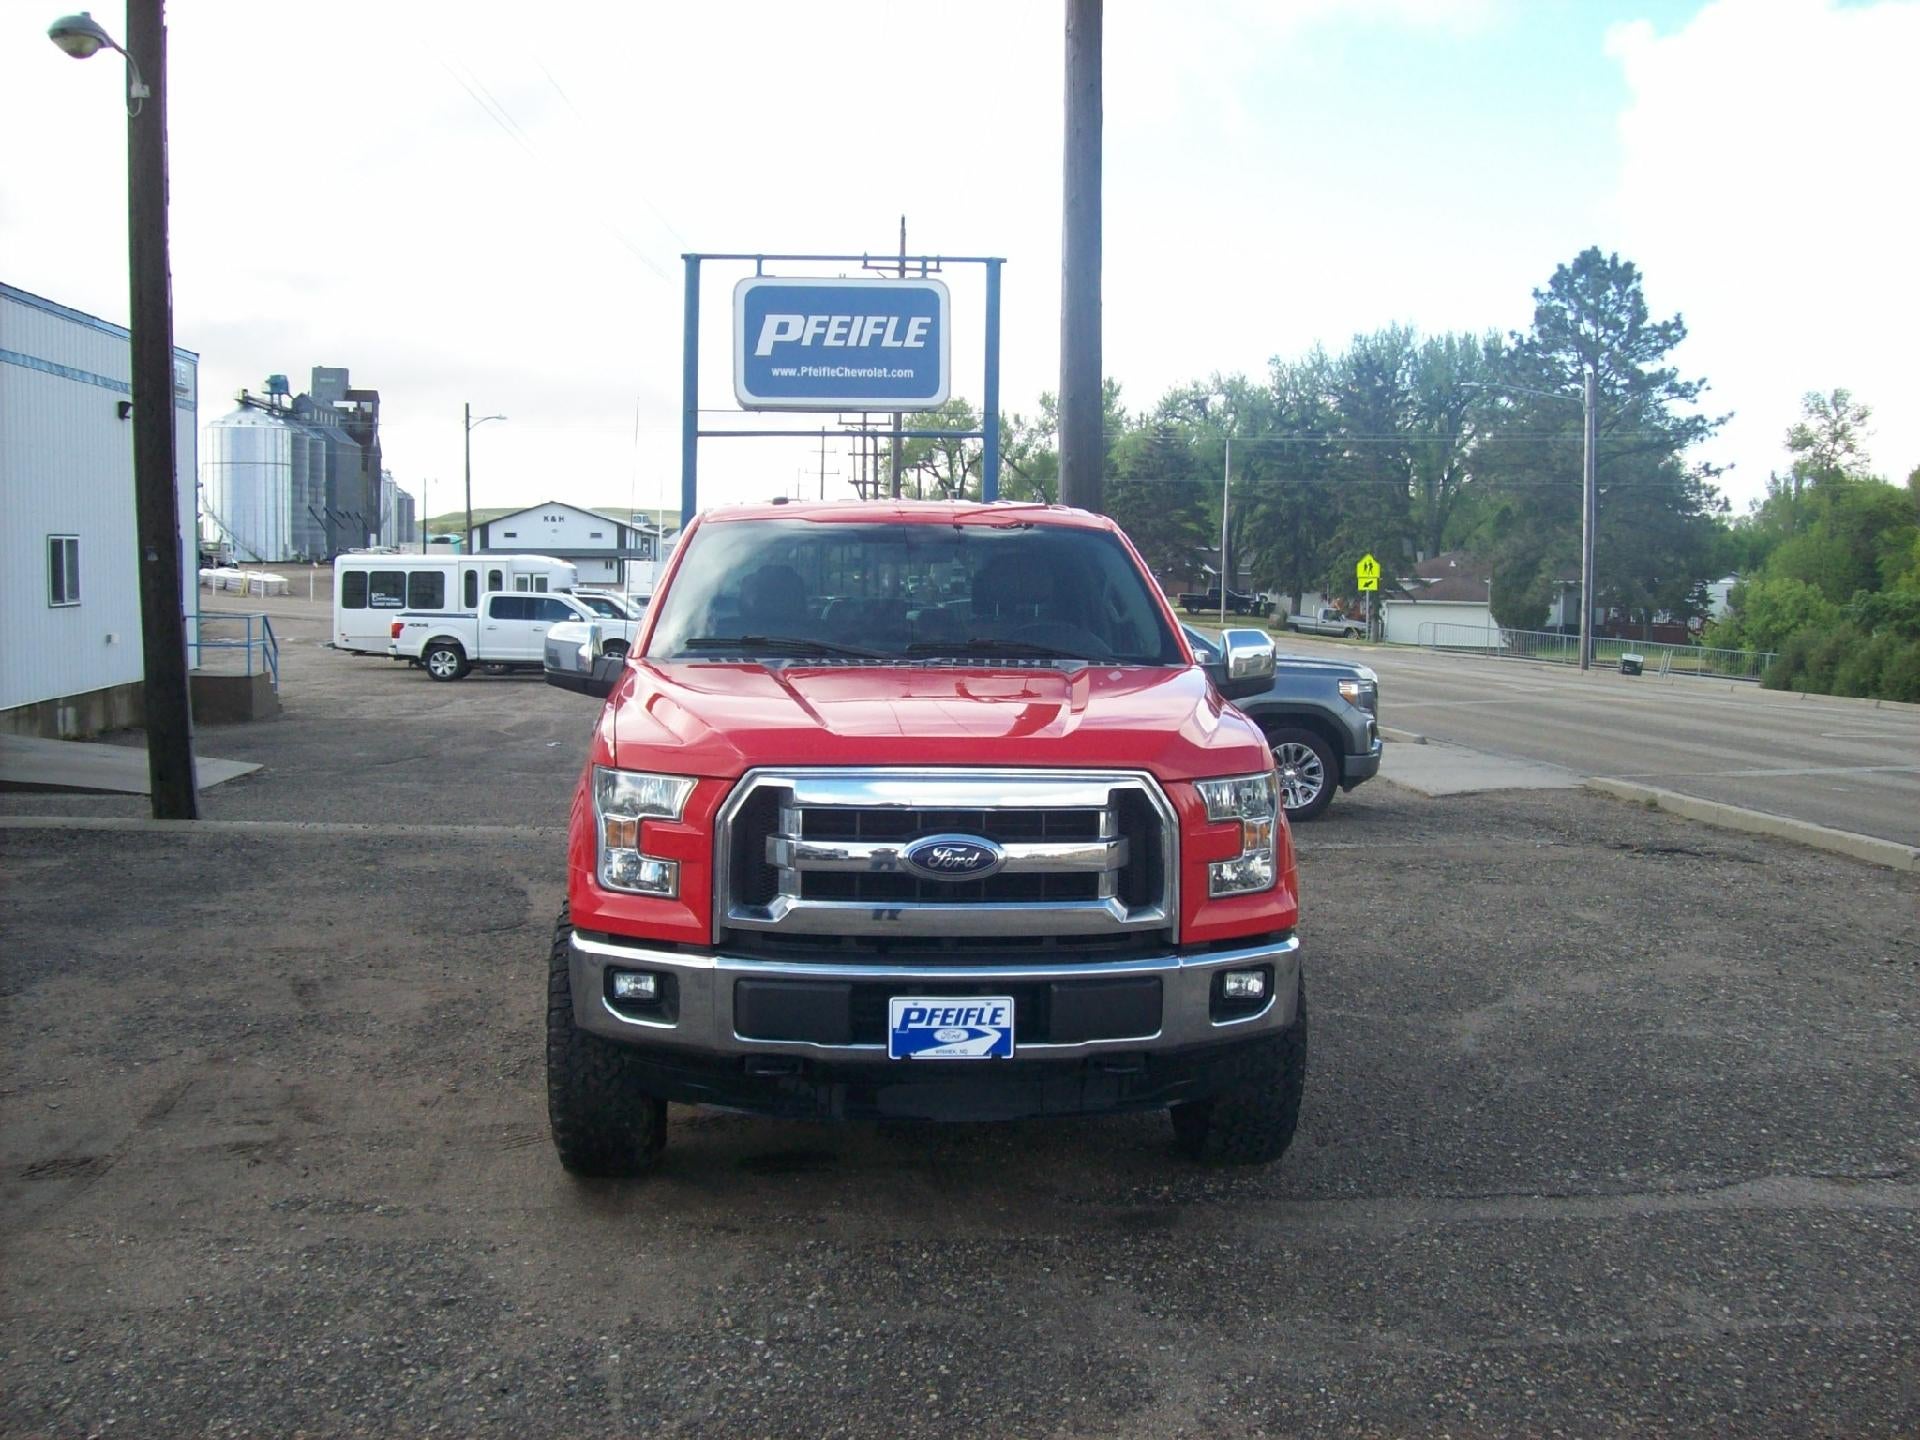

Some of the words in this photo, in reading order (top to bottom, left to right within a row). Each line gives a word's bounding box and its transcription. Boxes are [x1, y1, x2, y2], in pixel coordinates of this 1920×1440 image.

[754, 314, 932, 356] PFEIFLE
[771, 366, 914, 379] www.PfeifleChevrolet.com
[927, 846, 980, 868] Ford
[895, 1007, 1005, 1034] PFEIFLE
